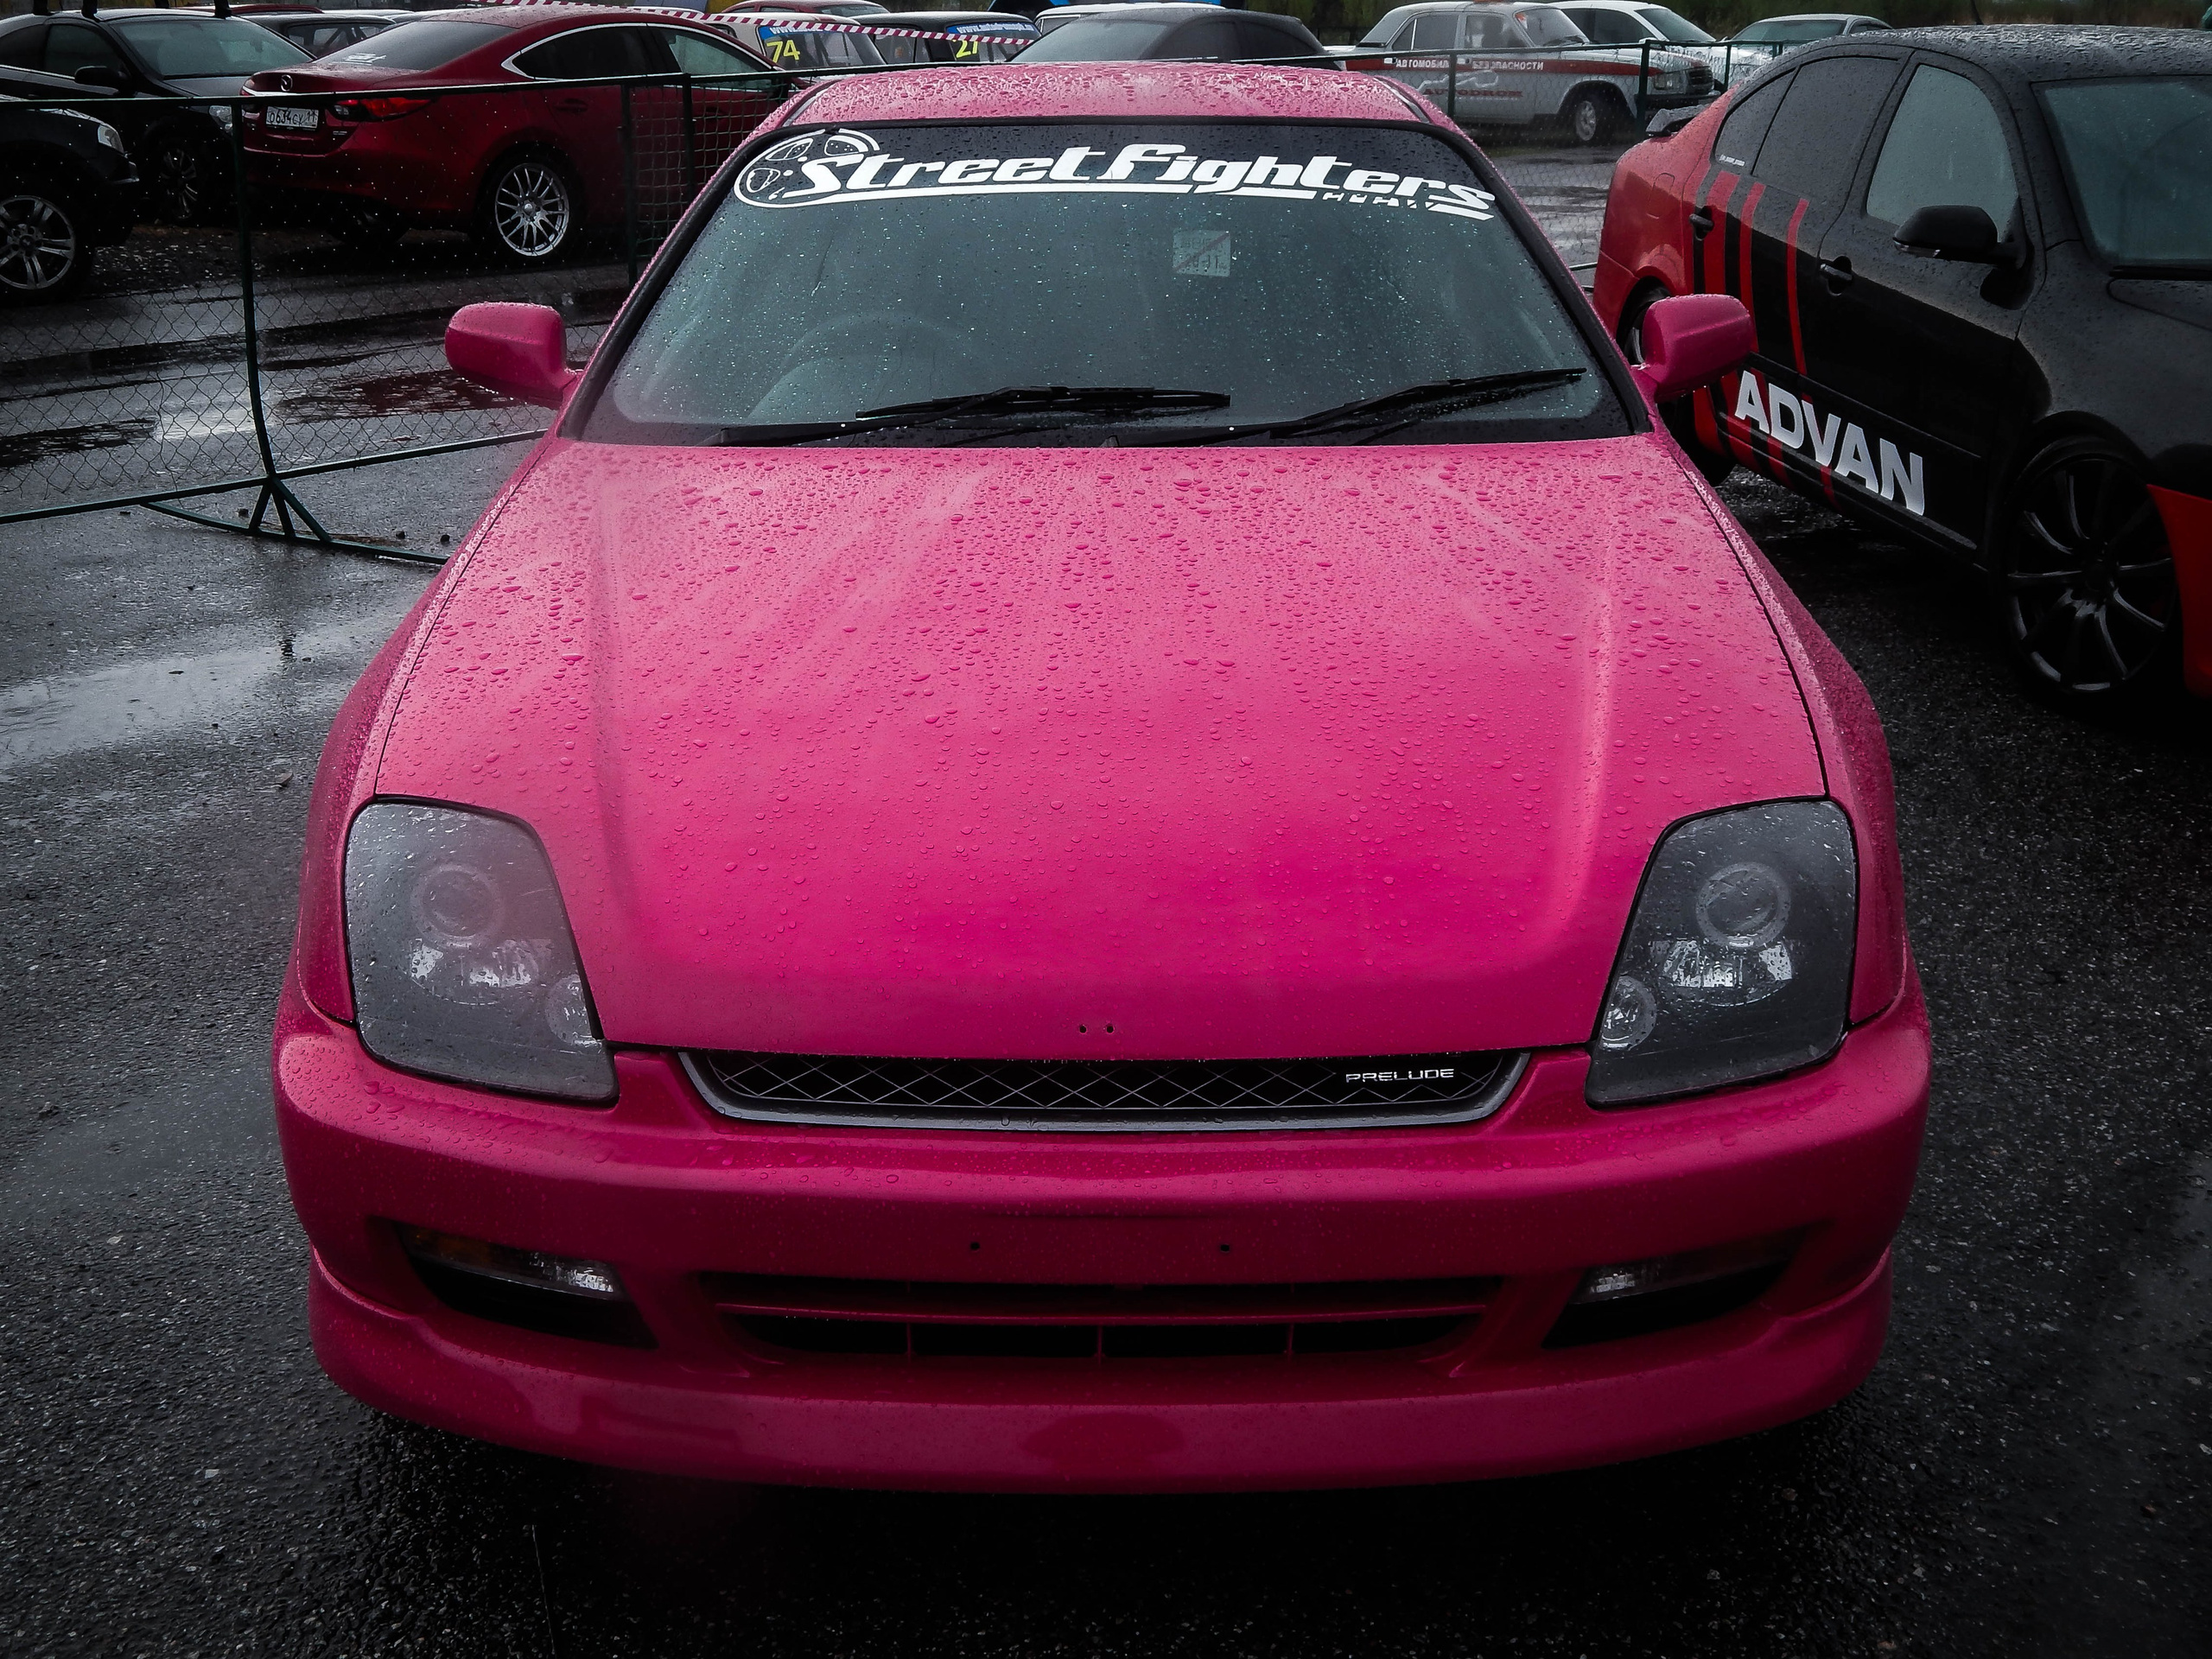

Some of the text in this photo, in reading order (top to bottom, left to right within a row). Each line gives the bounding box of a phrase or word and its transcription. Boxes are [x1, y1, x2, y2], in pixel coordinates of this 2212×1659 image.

[766, 40, 800, 63] 74
[1395, 59, 1450, 68] АВТОМОБИЛ
[1735, 370, 1925, 516] ADVAN
[1345, 1068, 1455, 1084] PRELUDE
